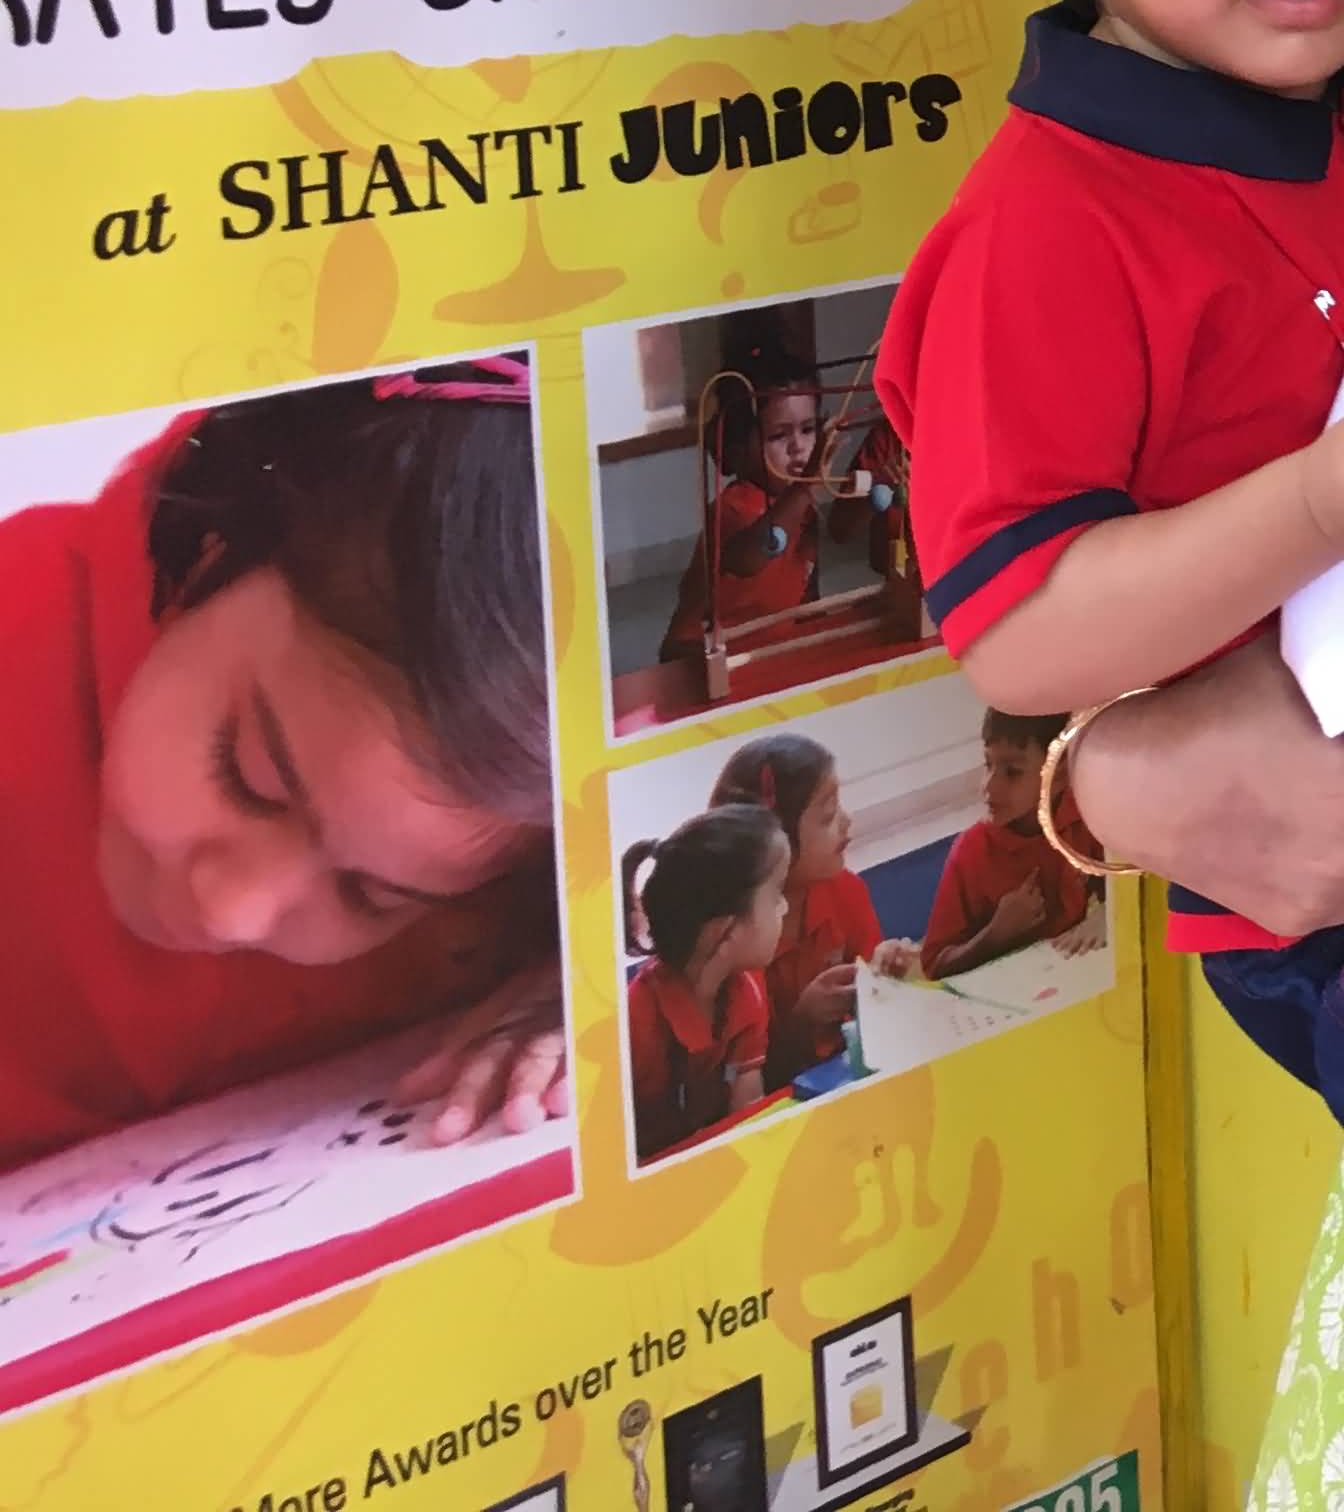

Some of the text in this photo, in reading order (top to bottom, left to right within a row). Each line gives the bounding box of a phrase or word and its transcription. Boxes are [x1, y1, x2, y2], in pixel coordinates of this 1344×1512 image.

[92, 192, 177, 260] at
[219, 121, 586, 242] SHANTI
[363, 1398, 522, 1498] Awards
[535, 1358, 617, 1422] over
[628, 1329, 687, 1377] the
[698, 1287, 775, 1345] Year
